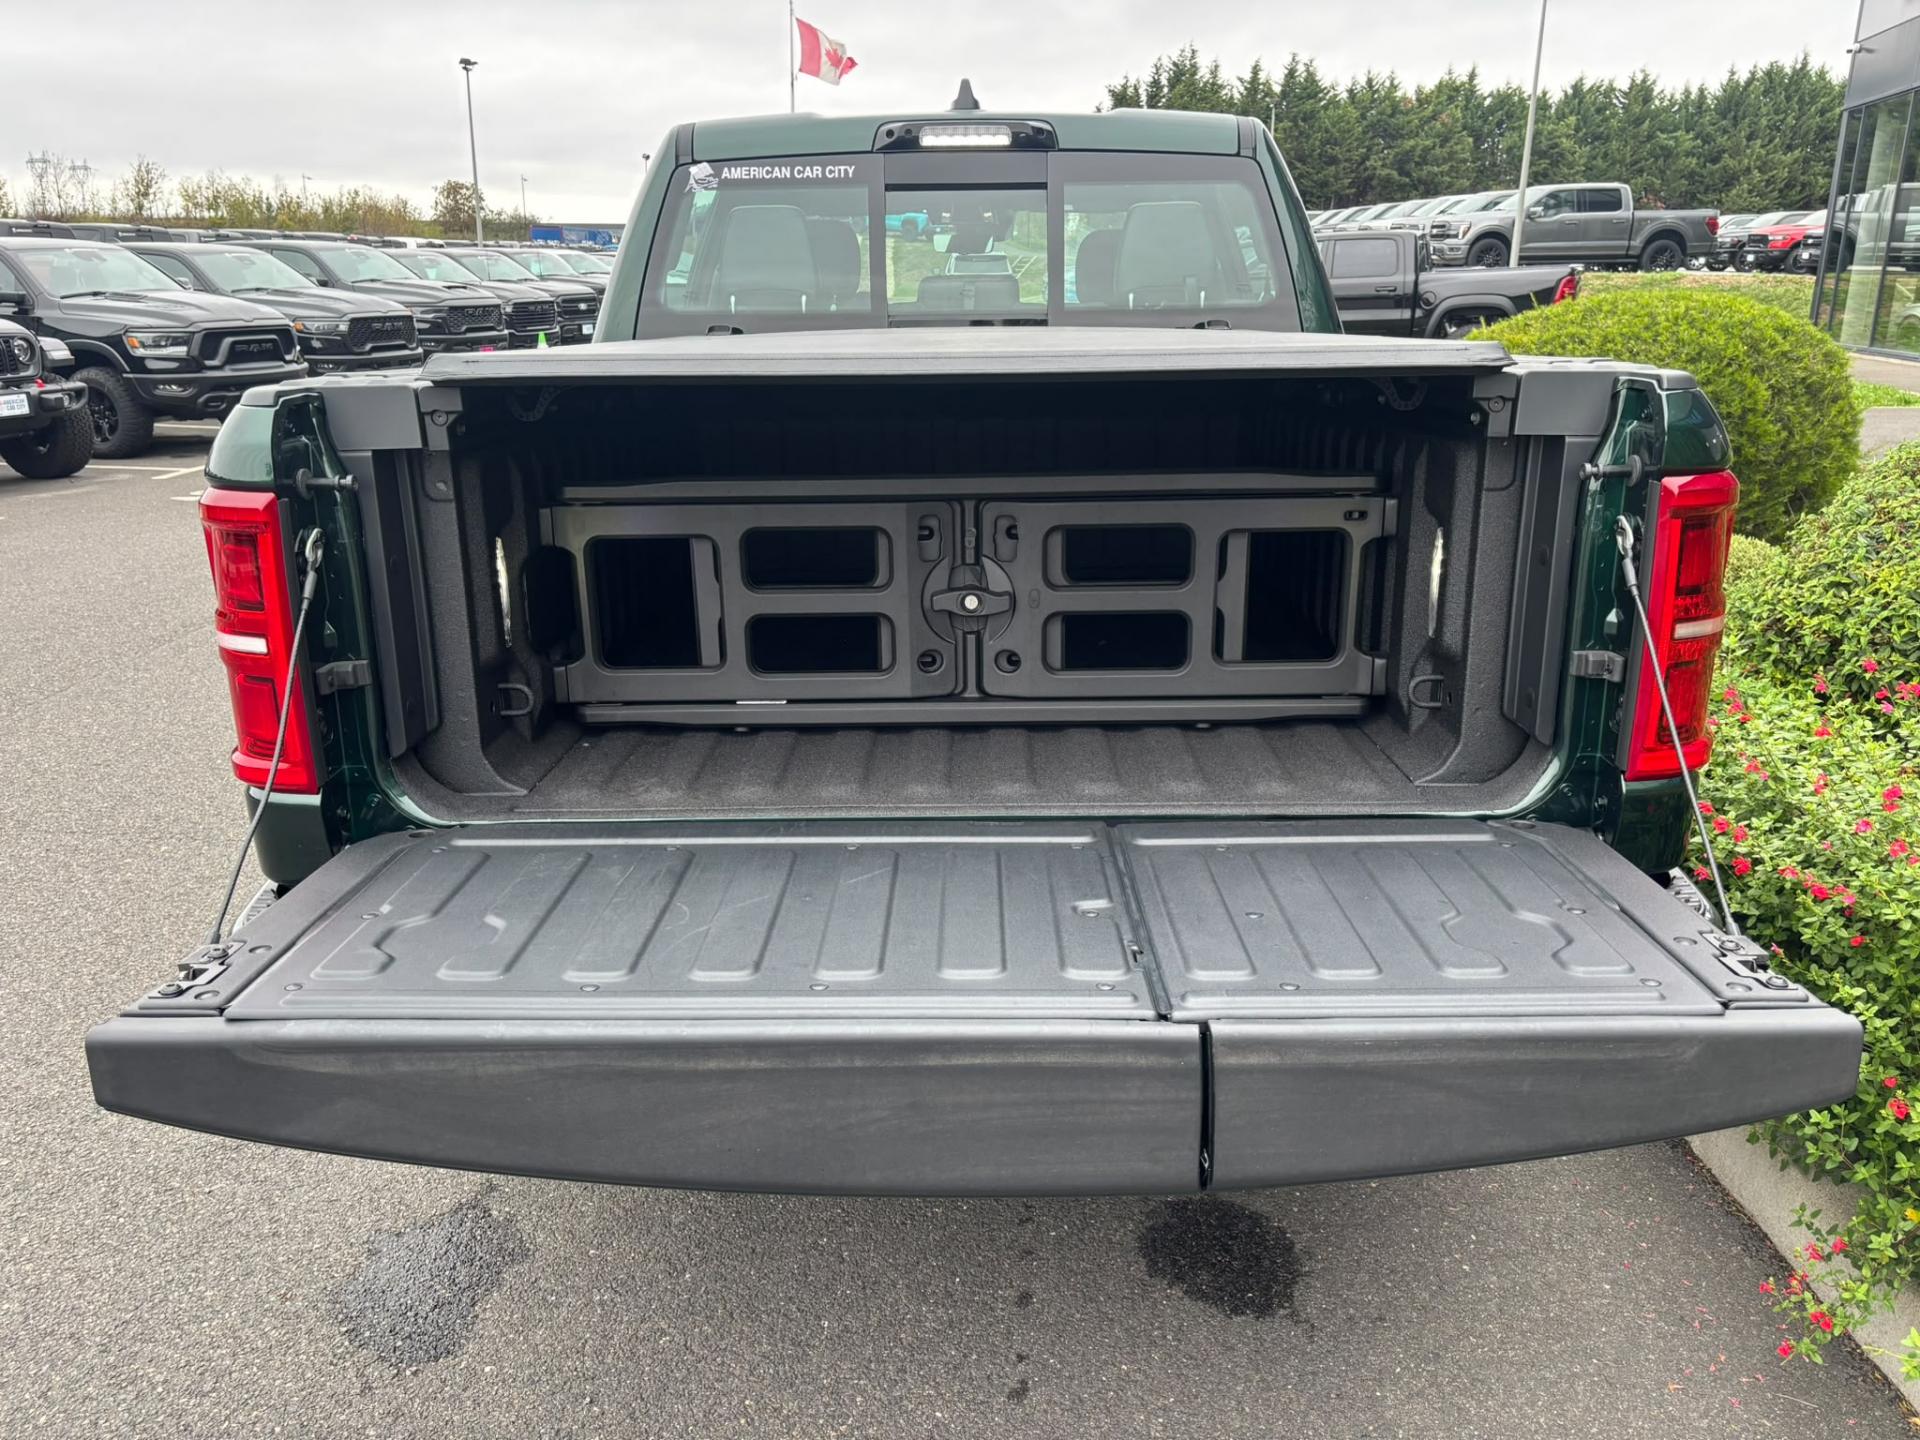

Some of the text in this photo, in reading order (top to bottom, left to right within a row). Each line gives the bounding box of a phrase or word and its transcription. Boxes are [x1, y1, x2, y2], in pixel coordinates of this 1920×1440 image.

[721, 165, 856, 179] AMERICAN CAR CITY
[234, 342, 273, 352] RAM
